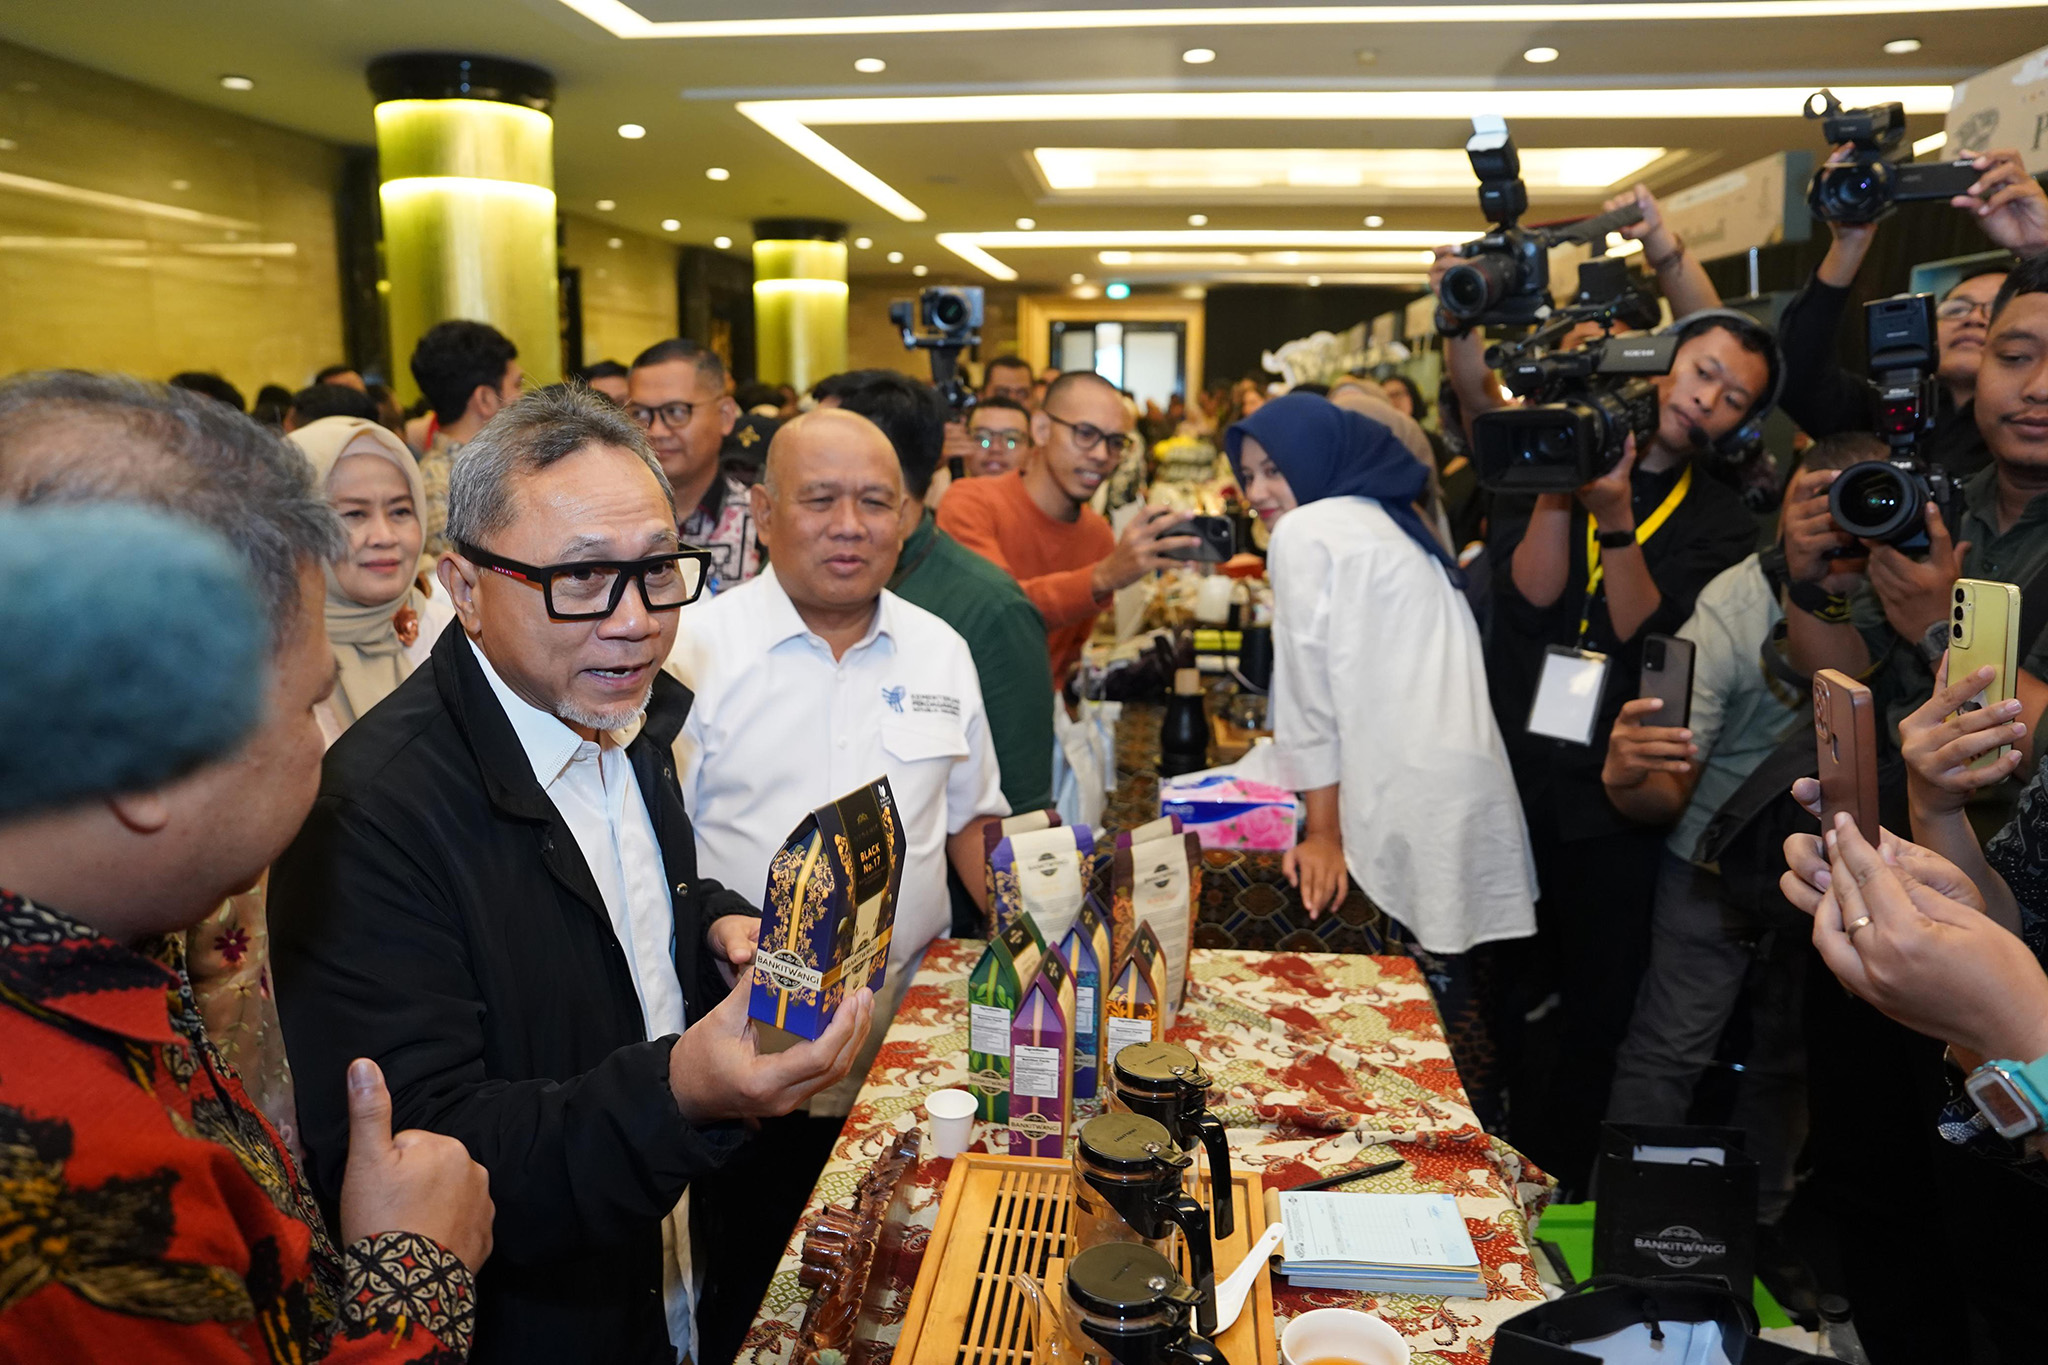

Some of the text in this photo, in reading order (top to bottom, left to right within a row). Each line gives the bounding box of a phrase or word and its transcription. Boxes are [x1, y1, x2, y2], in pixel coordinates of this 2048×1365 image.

[860, 842, 880, 862] BLACK
[863, 855, 881, 874] No.17
[756, 954, 820, 985] BANKITWANGI
[1011, 1121, 1059, 1132] BANKITWANGI
[1634, 1238, 1726, 1254] BANKITWANGI
